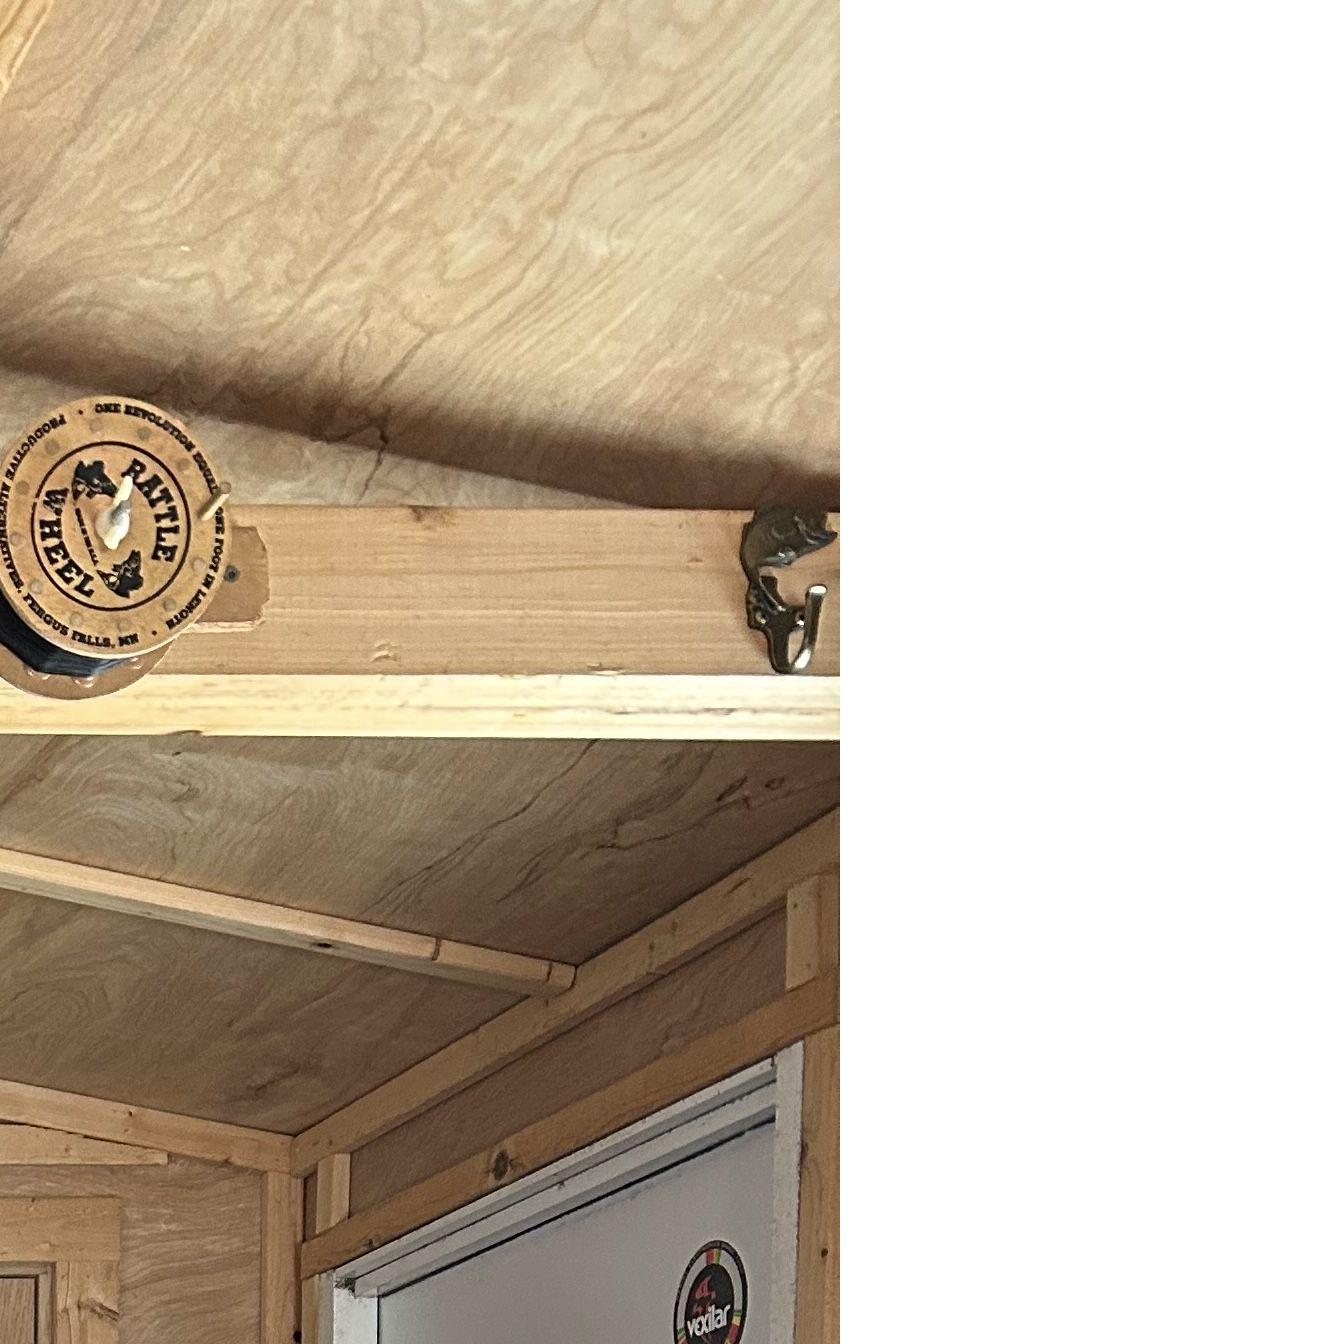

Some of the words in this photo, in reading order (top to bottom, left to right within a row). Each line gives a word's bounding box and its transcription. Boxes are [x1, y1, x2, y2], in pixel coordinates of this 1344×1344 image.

[39, 487, 95, 598] WHEEL
[120, 457, 180, 563] RATTLE
[22, 592, 69, 636] FERGUS
